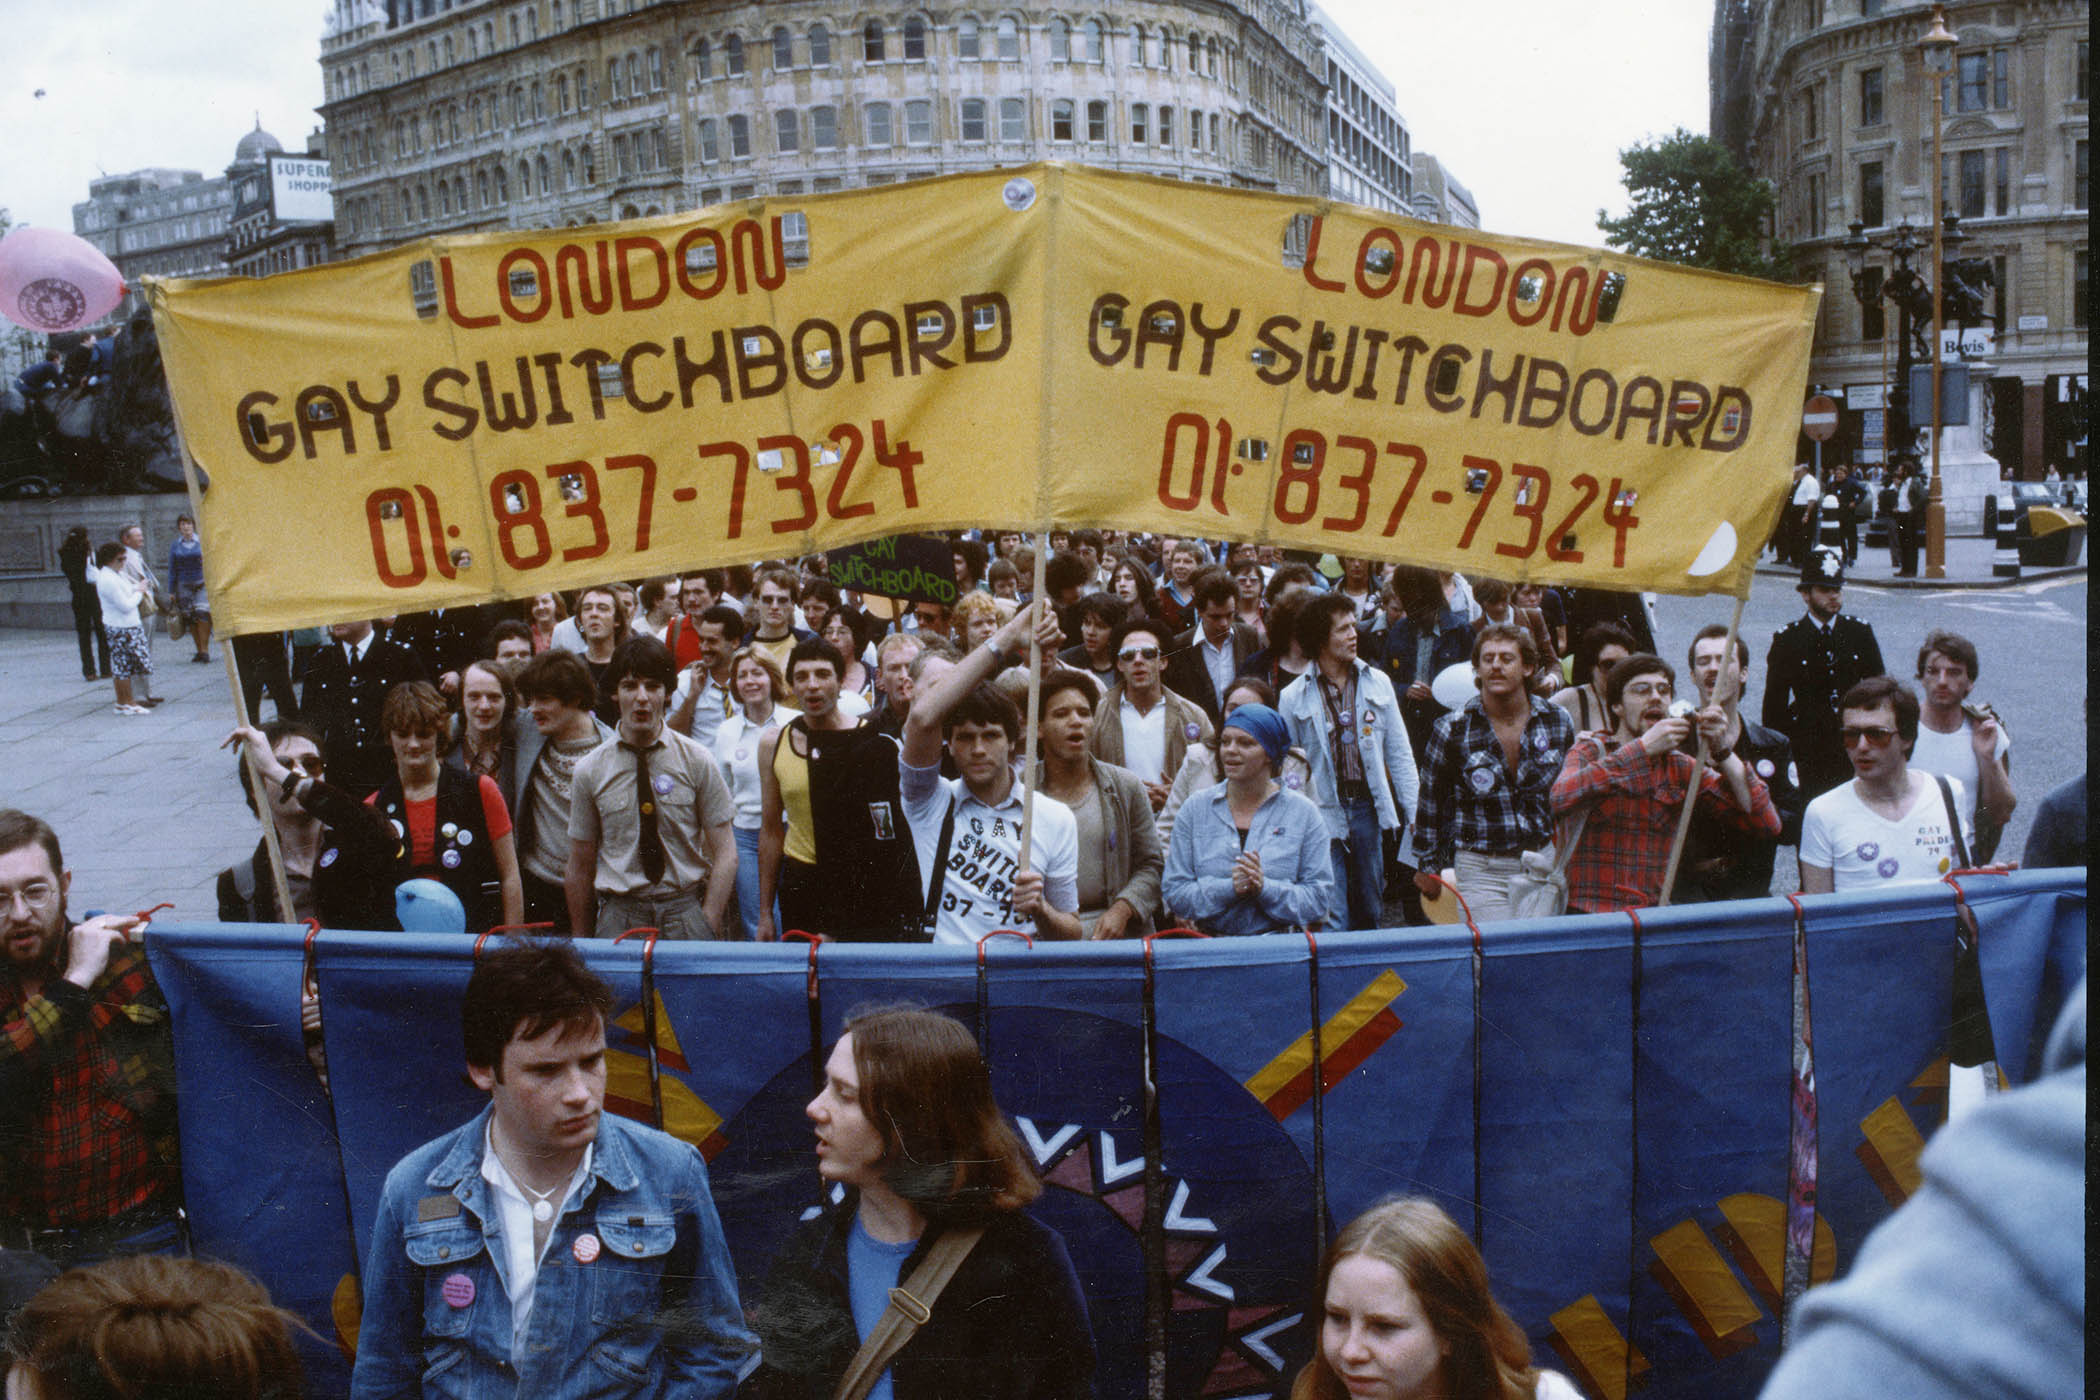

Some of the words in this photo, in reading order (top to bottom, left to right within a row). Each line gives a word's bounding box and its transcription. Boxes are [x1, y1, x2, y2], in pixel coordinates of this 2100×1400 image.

[440, 216, 787, 329] LONDON
[1304, 215, 1608, 336] LONDON
[236, 374, 401, 464] GAY
[423, 291, 1012, 442] SWITCHBOARD
[1088, 292, 1241, 376] GAY
[1254, 314, 1753, 453] SWITCHBOARD
[490, 420, 924, 571] 837-7324
[1274, 428, 1640, 568] 837-7324
[829, 554, 956, 602] SWITCHBOARD
[970, 817, 1024, 840] GAY
[1918, 826, 1941, 835] GAY
